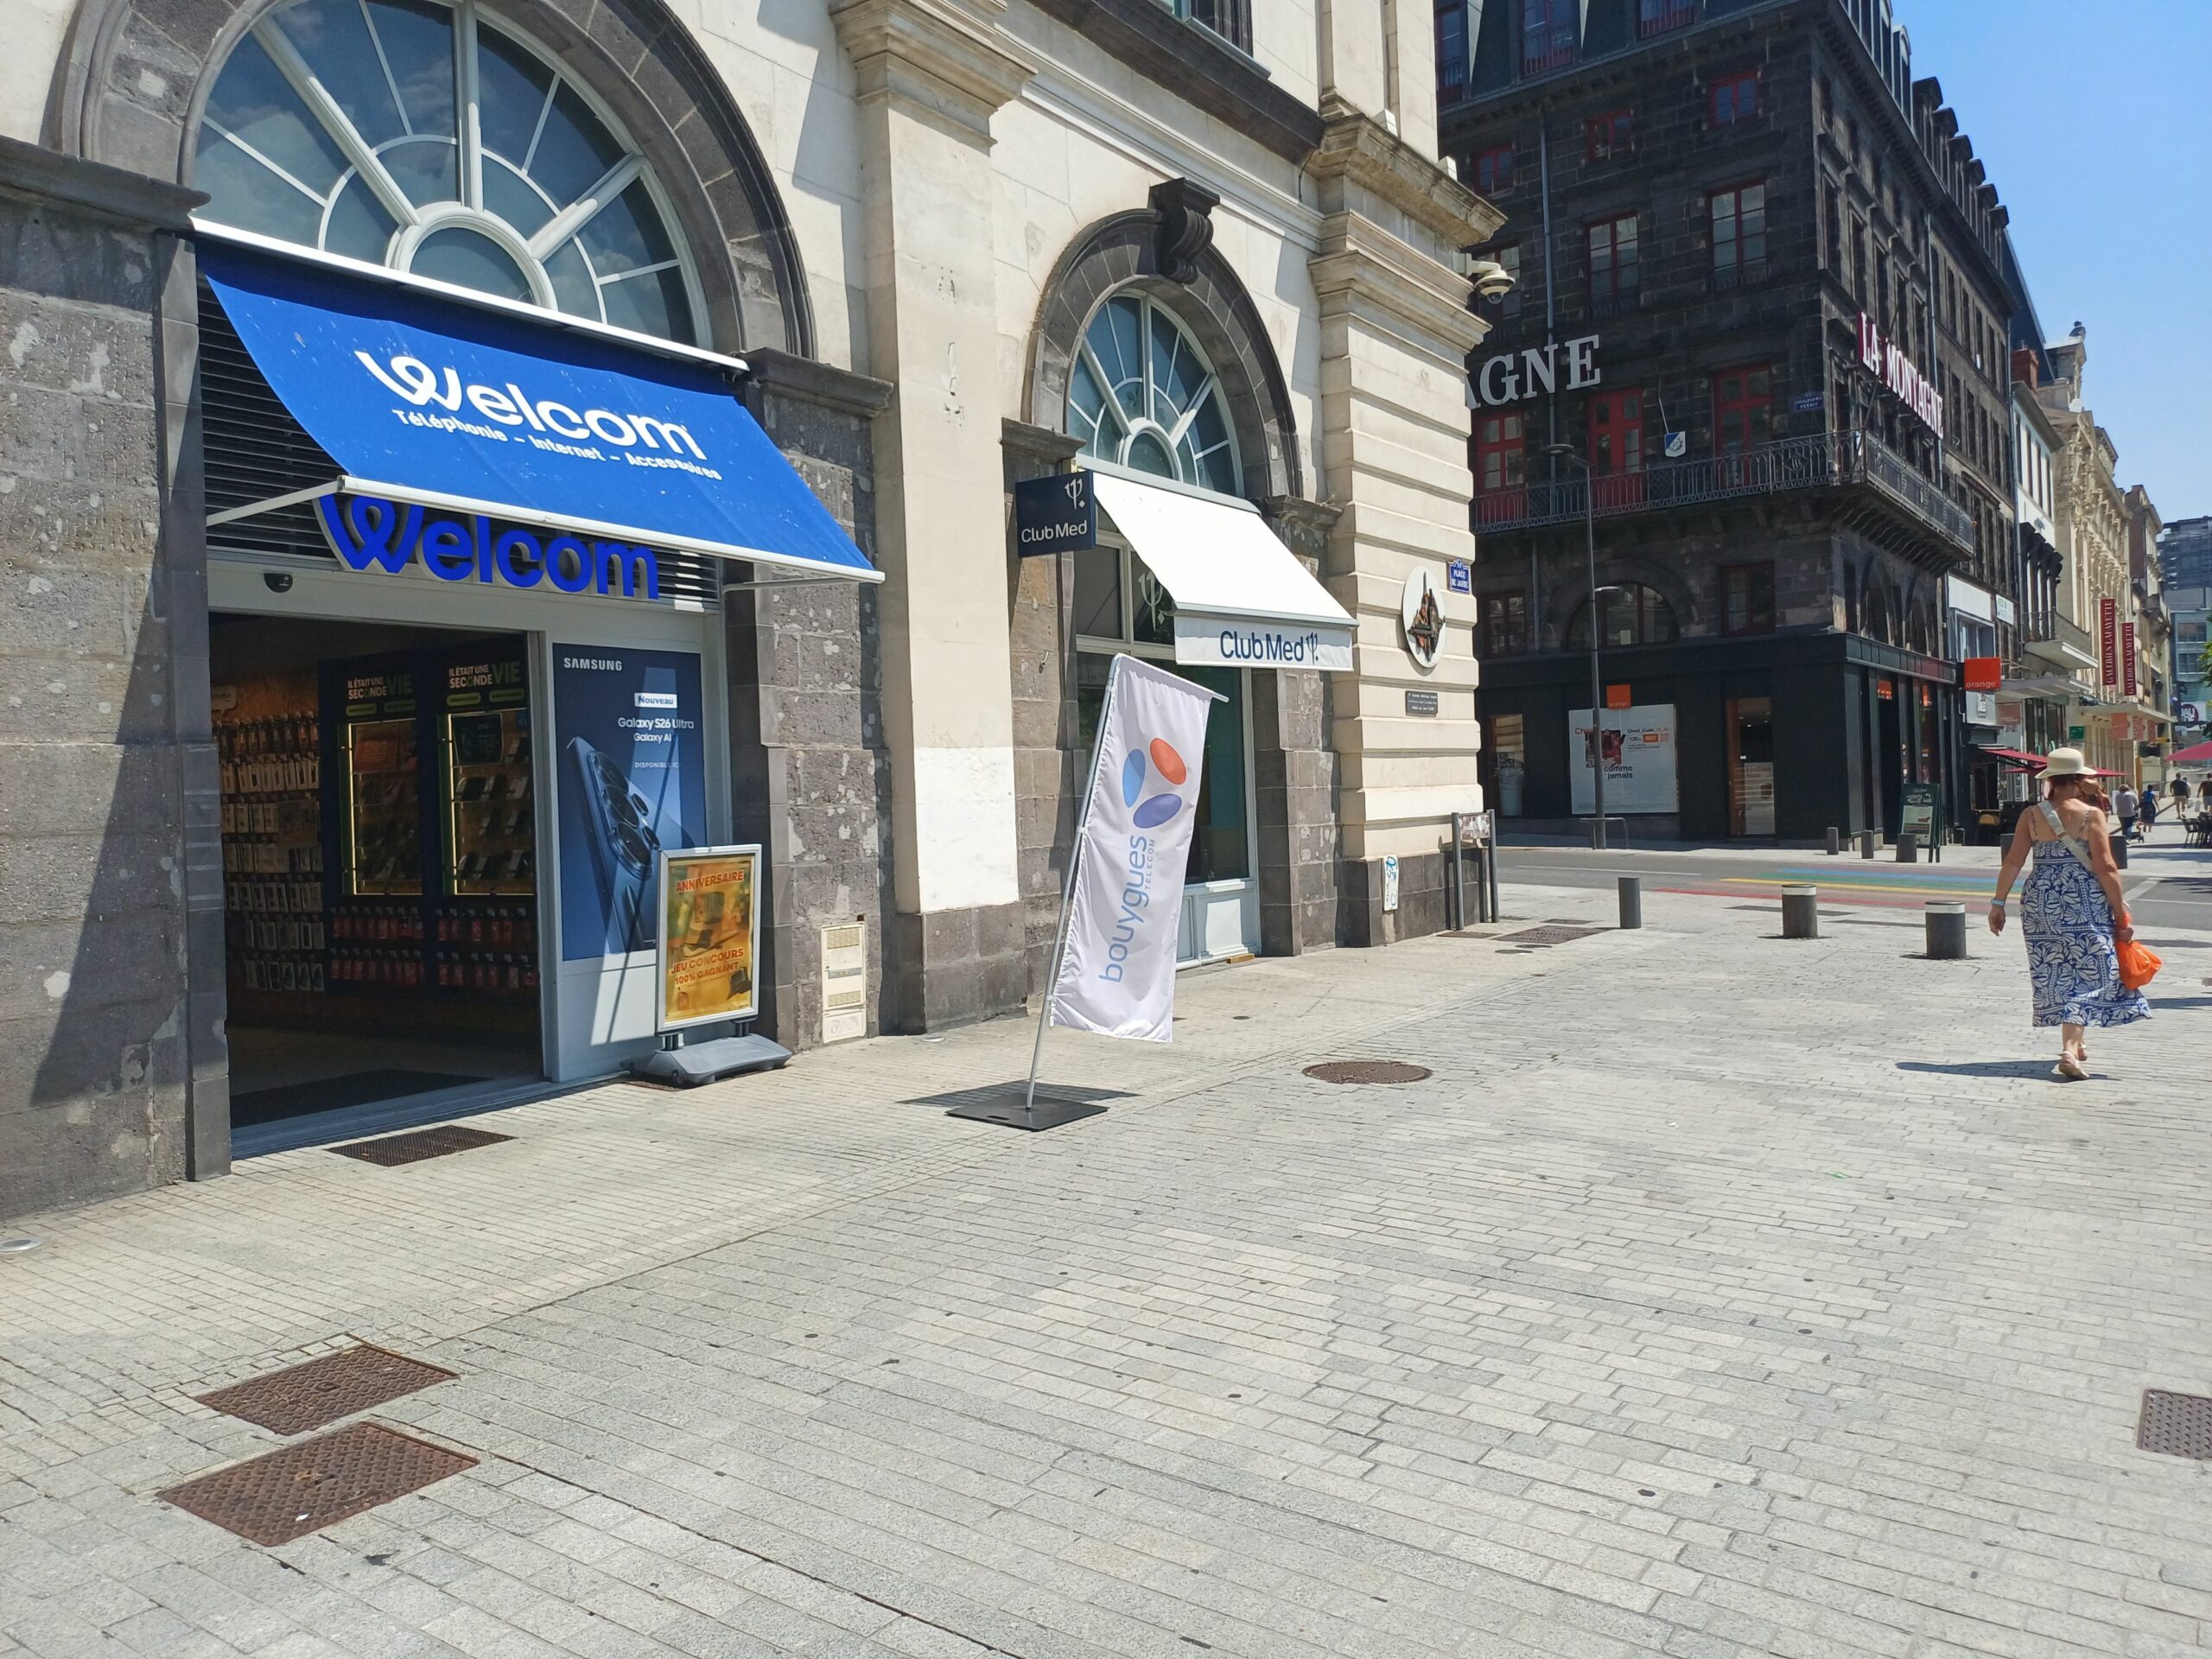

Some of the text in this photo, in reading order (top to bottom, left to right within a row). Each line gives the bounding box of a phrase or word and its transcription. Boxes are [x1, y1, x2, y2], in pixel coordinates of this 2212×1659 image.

[1860, 311, 1944, 440] LA MONTAGNE
[354, 350, 706, 460] Welcom
[391, 408, 508, 443] Téléphonie
[527, 435, 606, 462] Internet
[627, 452, 723, 481] Accessoires
[1020, 519, 1088, 543] Club Med
[315, 493, 660, 600] Welcom
[1453, 569, 1466, 579] PLACE
[1220, 630, 1305, 663] Club Med
[2104, 601, 2114, 683] GALERIES LAFAYETTE
[449, 662, 520, 689] SECONDE VIE
[474, 664, 490, 674] UNE
[563, 658, 623, 671] SAMSUNG
[371, 677, 385, 686] UNE
[1965, 680, 1997, 690] orange
[638, 695, 674, 705] Nouveau
[618, 717, 695, 731] Galaxy S26 Ultra
[633, 733, 671, 744] Galaxy AI
[1144, 838, 1155, 890] TELECOM
[676, 870, 744, 893] ANNIVERSAIRE
[1098, 835, 1150, 983] bouygues
[671, 948, 744, 975] JEU CONCOURS
[675, 962, 739, 985] 100% GAGNANT
